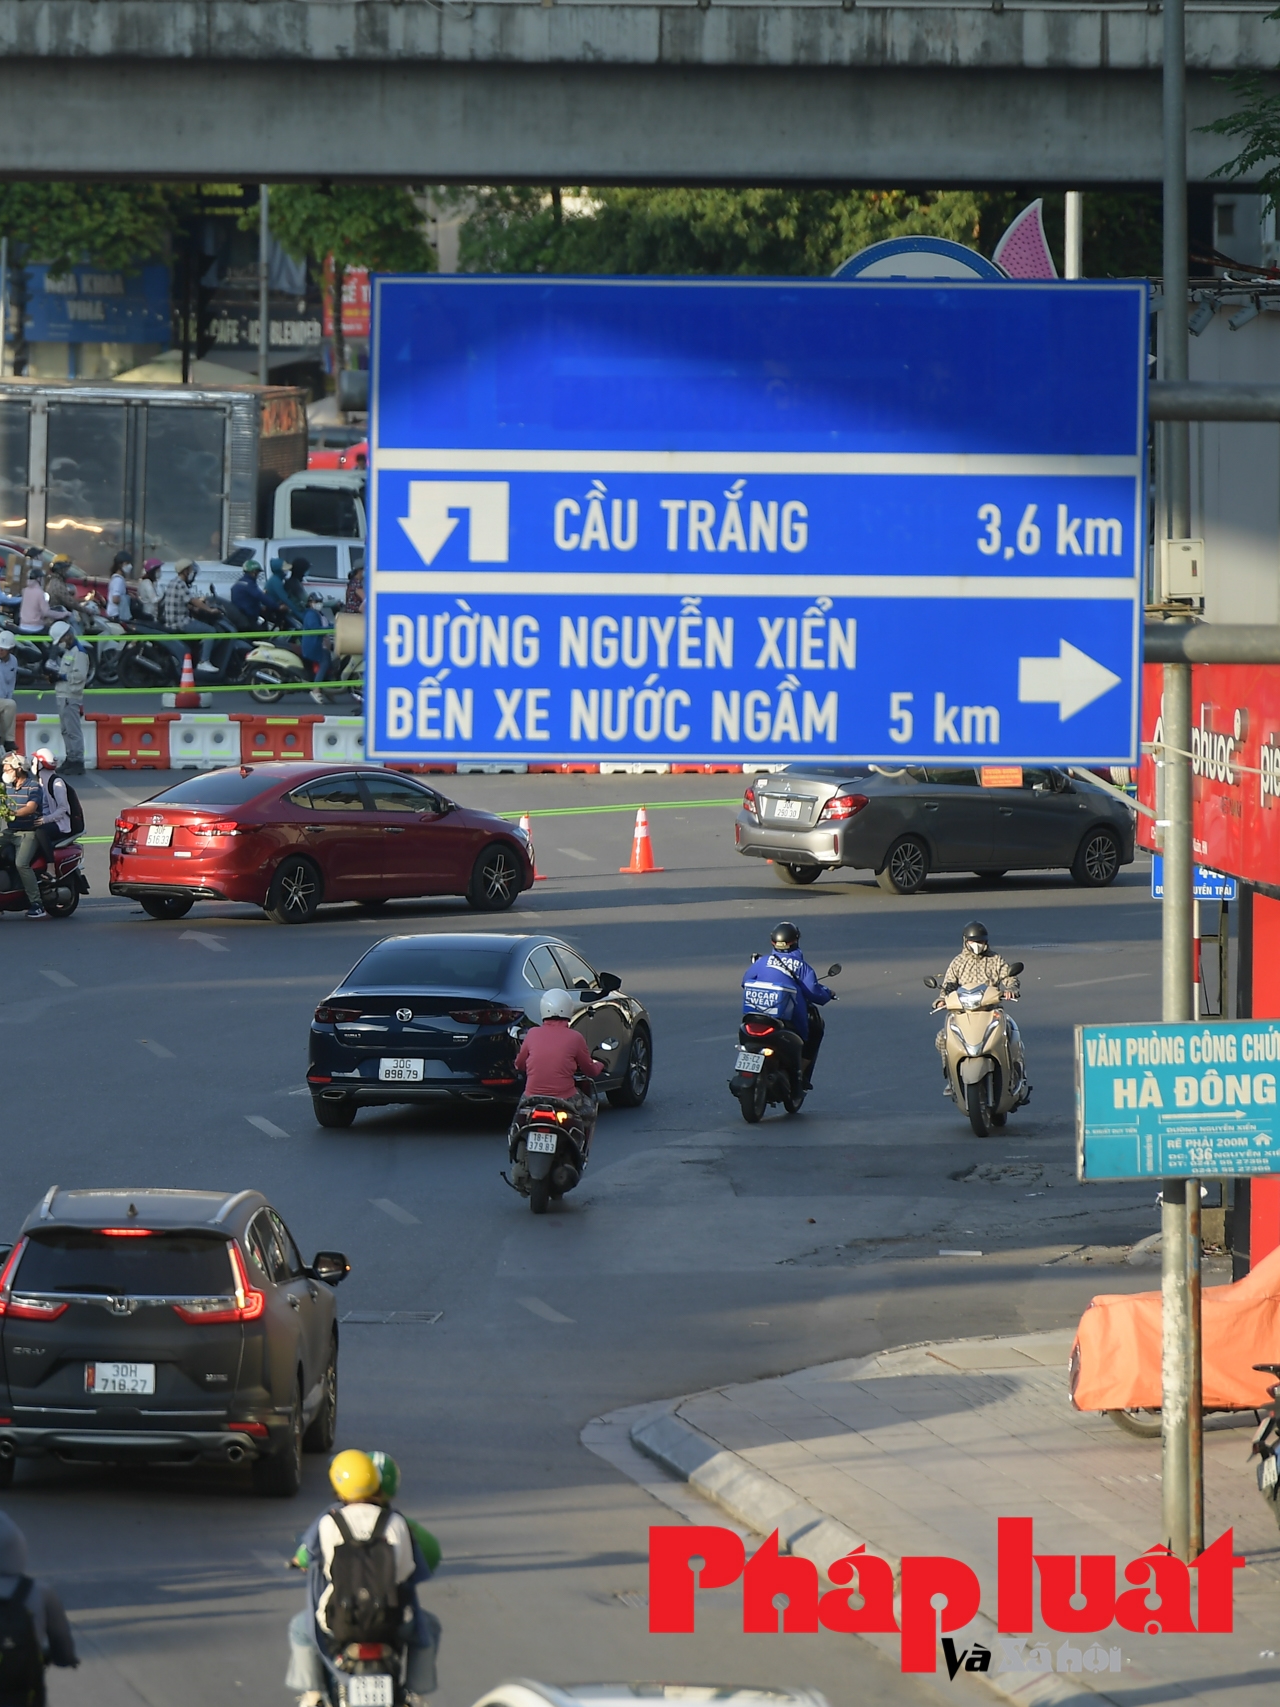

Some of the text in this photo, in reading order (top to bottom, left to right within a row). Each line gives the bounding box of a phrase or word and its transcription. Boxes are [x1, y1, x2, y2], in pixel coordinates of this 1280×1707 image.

[554, 478, 1123, 561] CẦU TRẮNG 3,6 km
[384, 595, 857, 670] ĐƯỜNG NGUYỄN XIỂN
[386, 668, 1000, 744] BẾN XE NƯỚC NGẦM 5 km
[147, 835, 170, 844] 516.33
[1086, 1033, 1121, 1067] VĂN
[1126, 1030, 1185, 1066] PHÒNG
[1190, 1029, 1237, 1064] CÔNG
[392, 1060, 412, 1069] 30G
[384, 1069, 419, 1079] 898.79
[1114, 1068, 1277, 1109] HÀ ĐÔNG
[1199, 1123, 1234, 1132] NGUYỄN
[533, 1133, 553, 1143] 18-E1
[1167, 1135, 1249, 1149] RẼ PHẢI 200M
[1189, 1147, 1213, 1161] 136
[1214, 1149, 1261, 1159] NGUYỄN
[12, 1346, 46, 1355] CR-V
[112, 1364, 138, 1377] 30H
